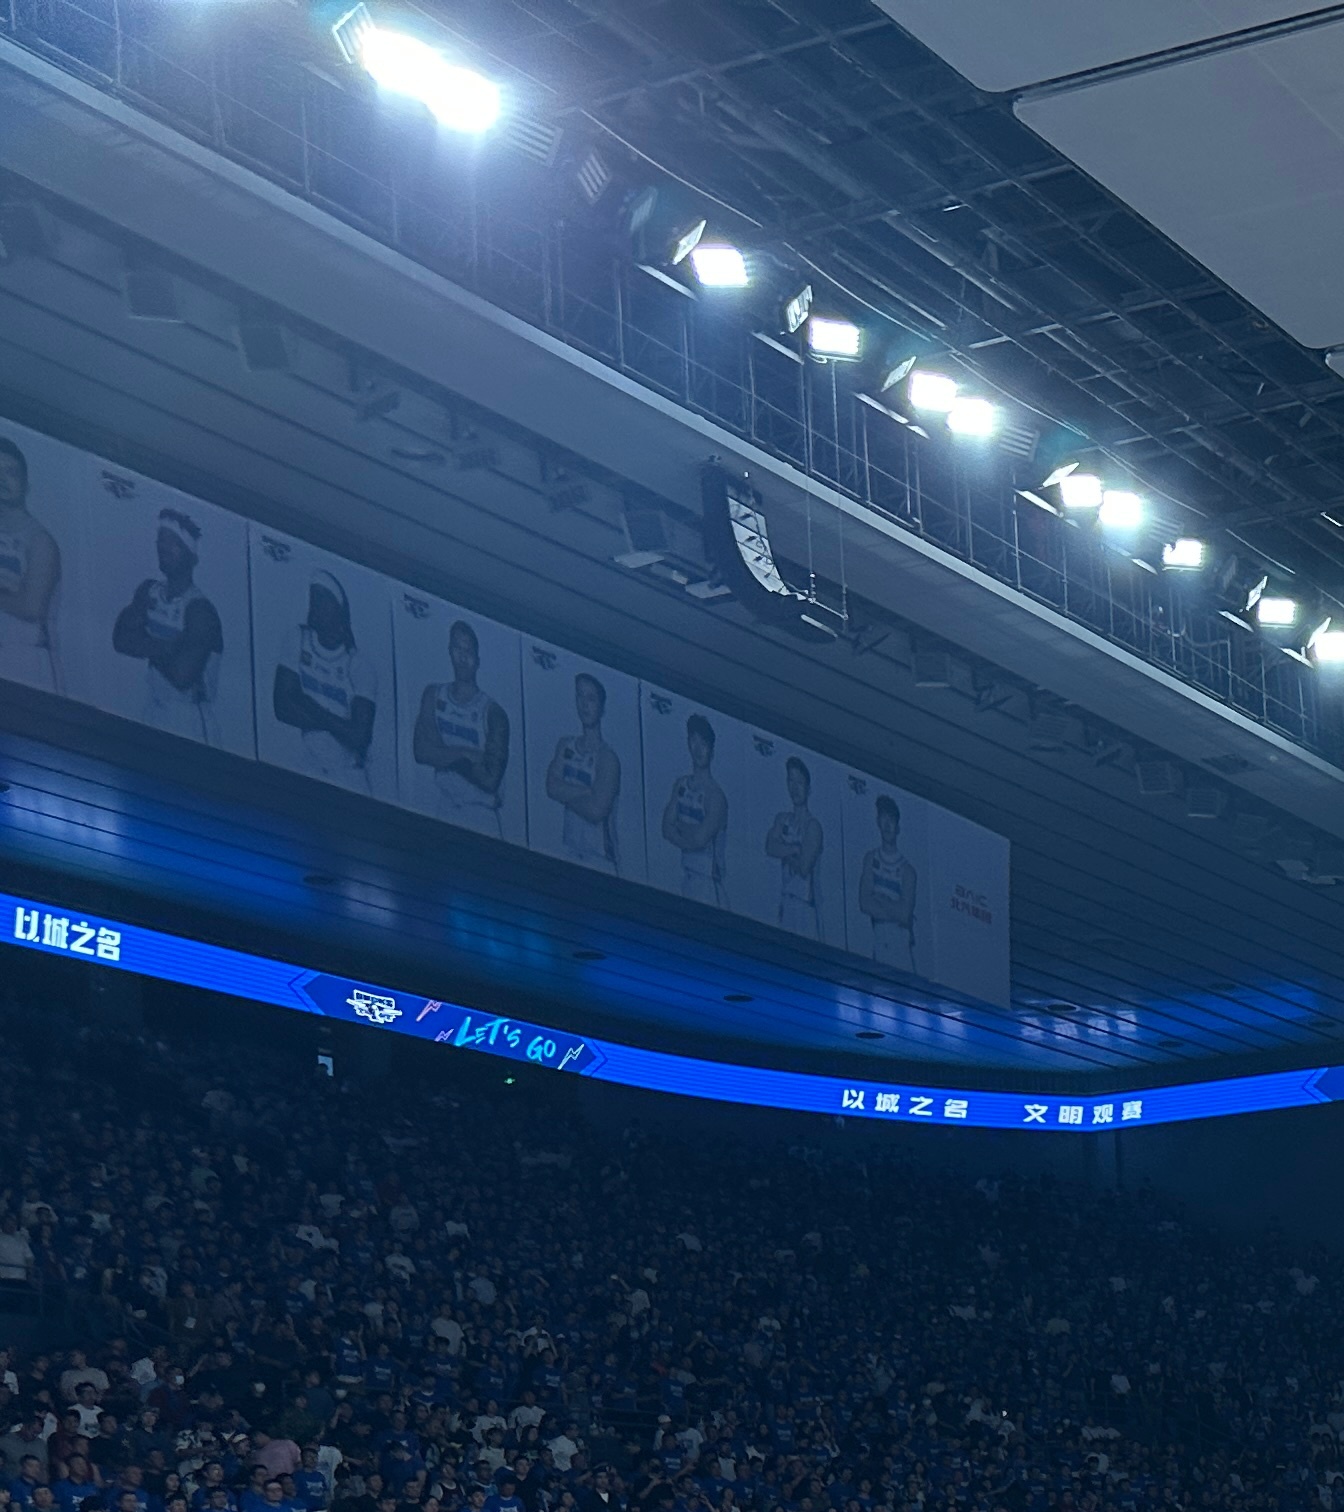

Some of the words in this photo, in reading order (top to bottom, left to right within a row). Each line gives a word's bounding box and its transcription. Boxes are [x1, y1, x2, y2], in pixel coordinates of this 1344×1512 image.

[14, 906, 122, 962] 以城之名
[455, 1015, 522, 1049] LET'S
[527, 1035, 556, 1062] GO
[842, 1089, 968, 1120] 以城之名
[1024, 1099, 1143, 1126] 文明观赛
